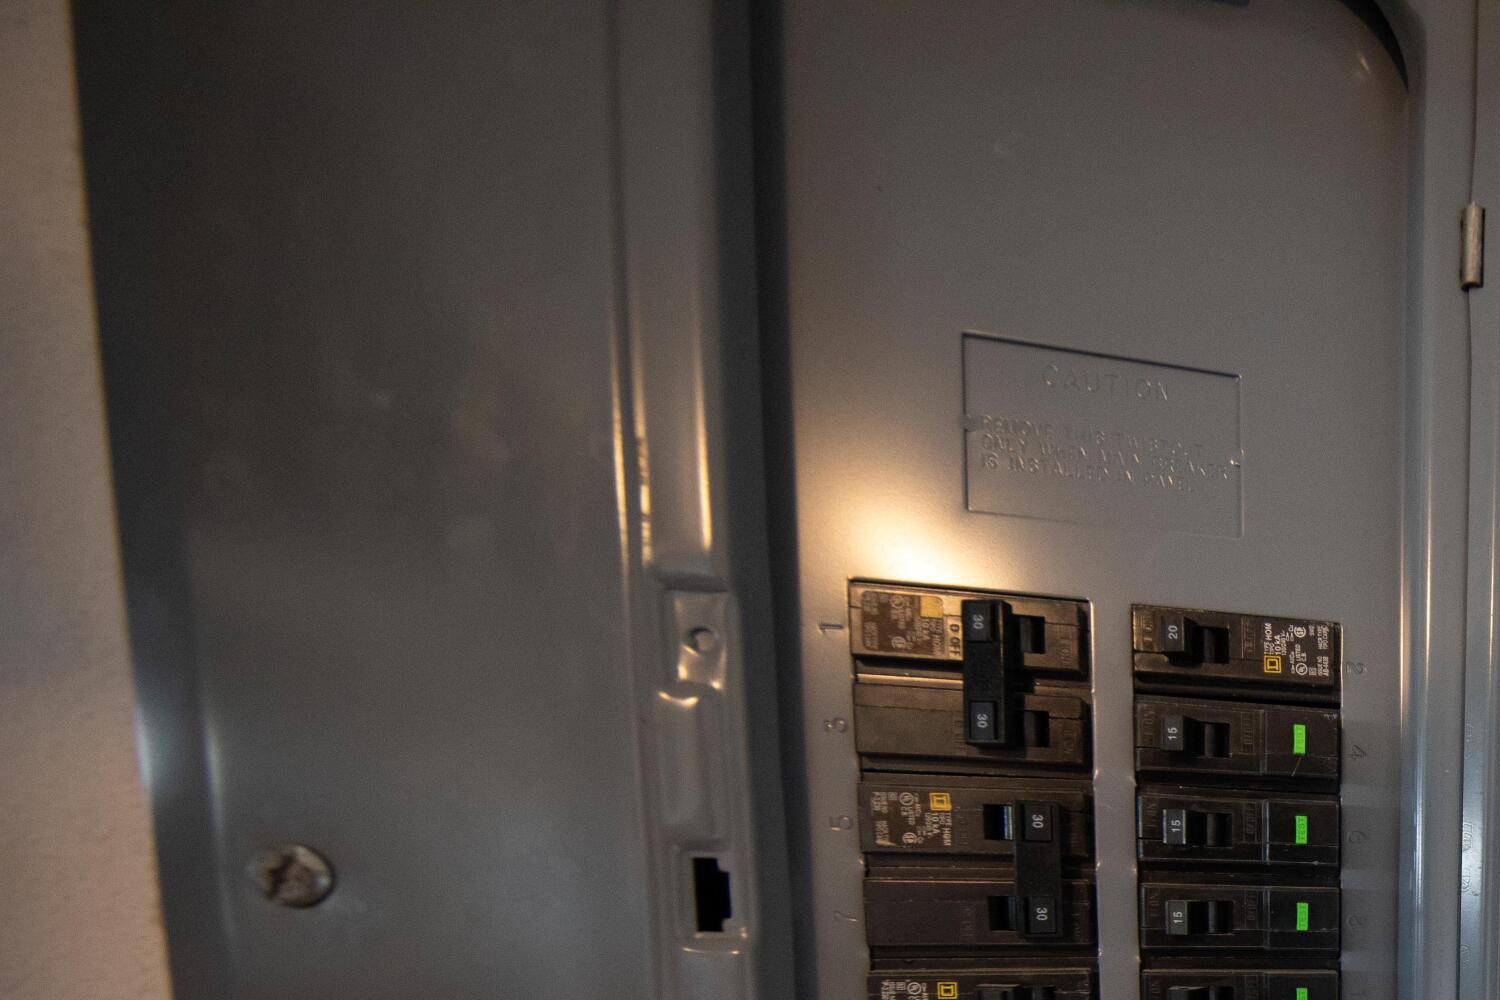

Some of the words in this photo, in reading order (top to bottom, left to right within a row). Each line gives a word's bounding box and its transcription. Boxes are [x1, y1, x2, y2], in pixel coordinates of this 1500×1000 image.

[1042, 364, 1169, 402] CAUTION
[973, 613, 985, 631] 30
[1168, 624, 1179, 640] 20
[1264, 623, 1272, 641] HOM
[976, 712, 988, 729] 30
[1168, 726, 1178, 741] 15
[1032, 813, 1044, 829] 30
[1171, 818, 1182, 834] 15
[1036, 906, 1048, 922] 30
[1172, 910, 1183, 924] 15
